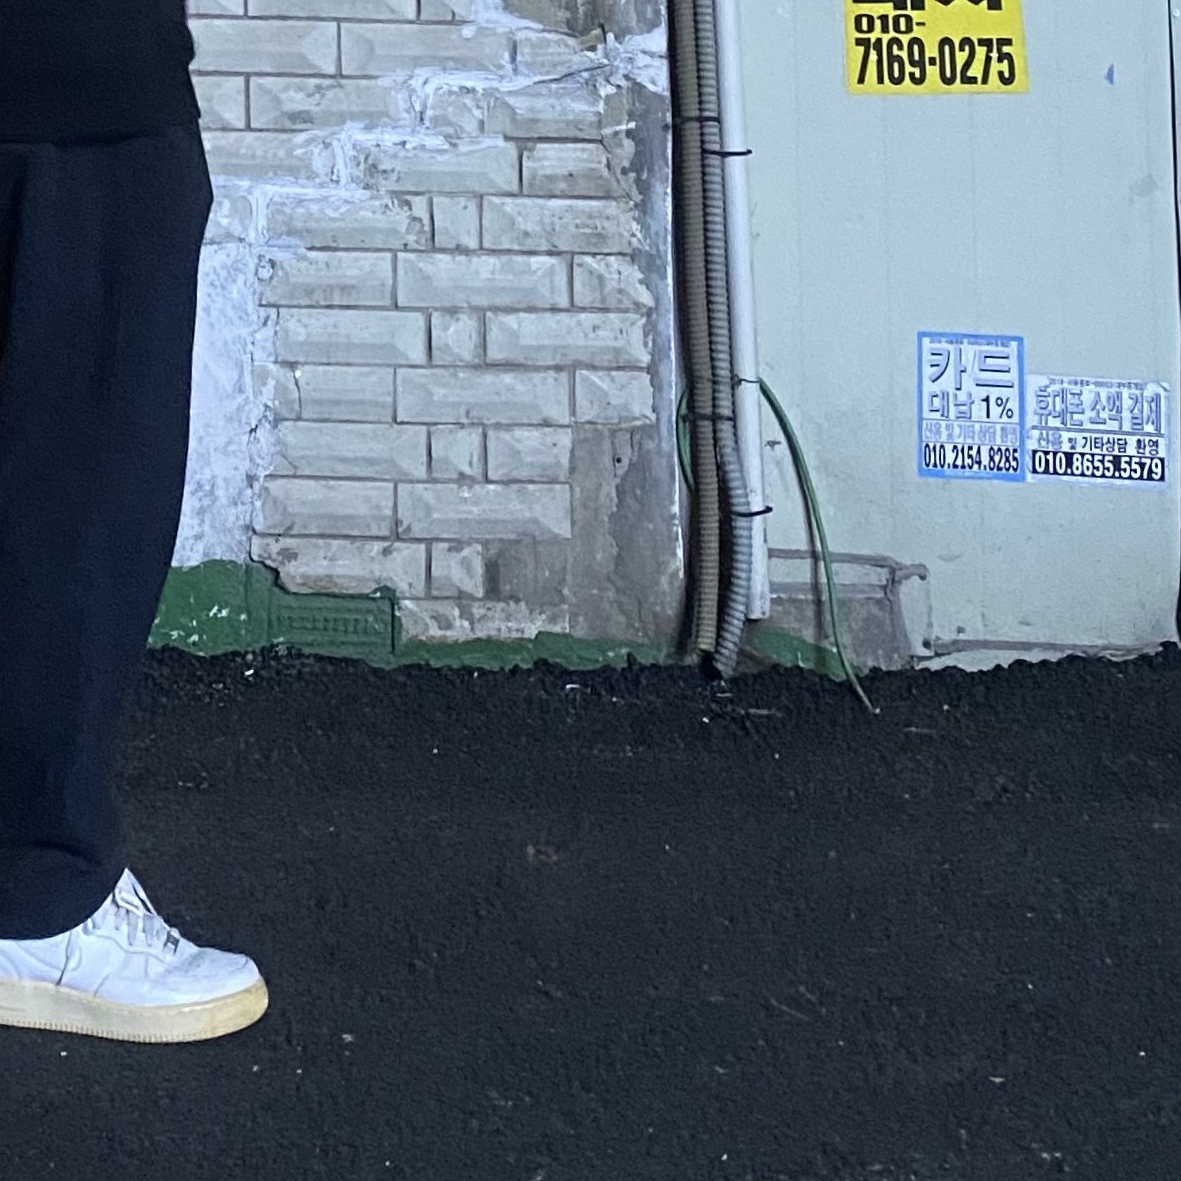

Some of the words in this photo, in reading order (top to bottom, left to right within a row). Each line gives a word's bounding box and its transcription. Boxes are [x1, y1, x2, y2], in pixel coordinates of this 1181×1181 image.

[854, 13, 926, 34] 010-
[929, 347, 1015, 391] 카드
[929, 391, 975, 420] 대납
[981, 394, 1014, 419] 1%
[1034, 385, 1085, 427] 휴대폰
[1089, 390, 1123, 431] 소액
[1128, 392, 1162, 434] 결제
[924, 443, 1019, 473] 010.2154.8285
[1135, 437, 1159, 456] 환영
[1034, 451, 1163, 480] 010.8655.5579
